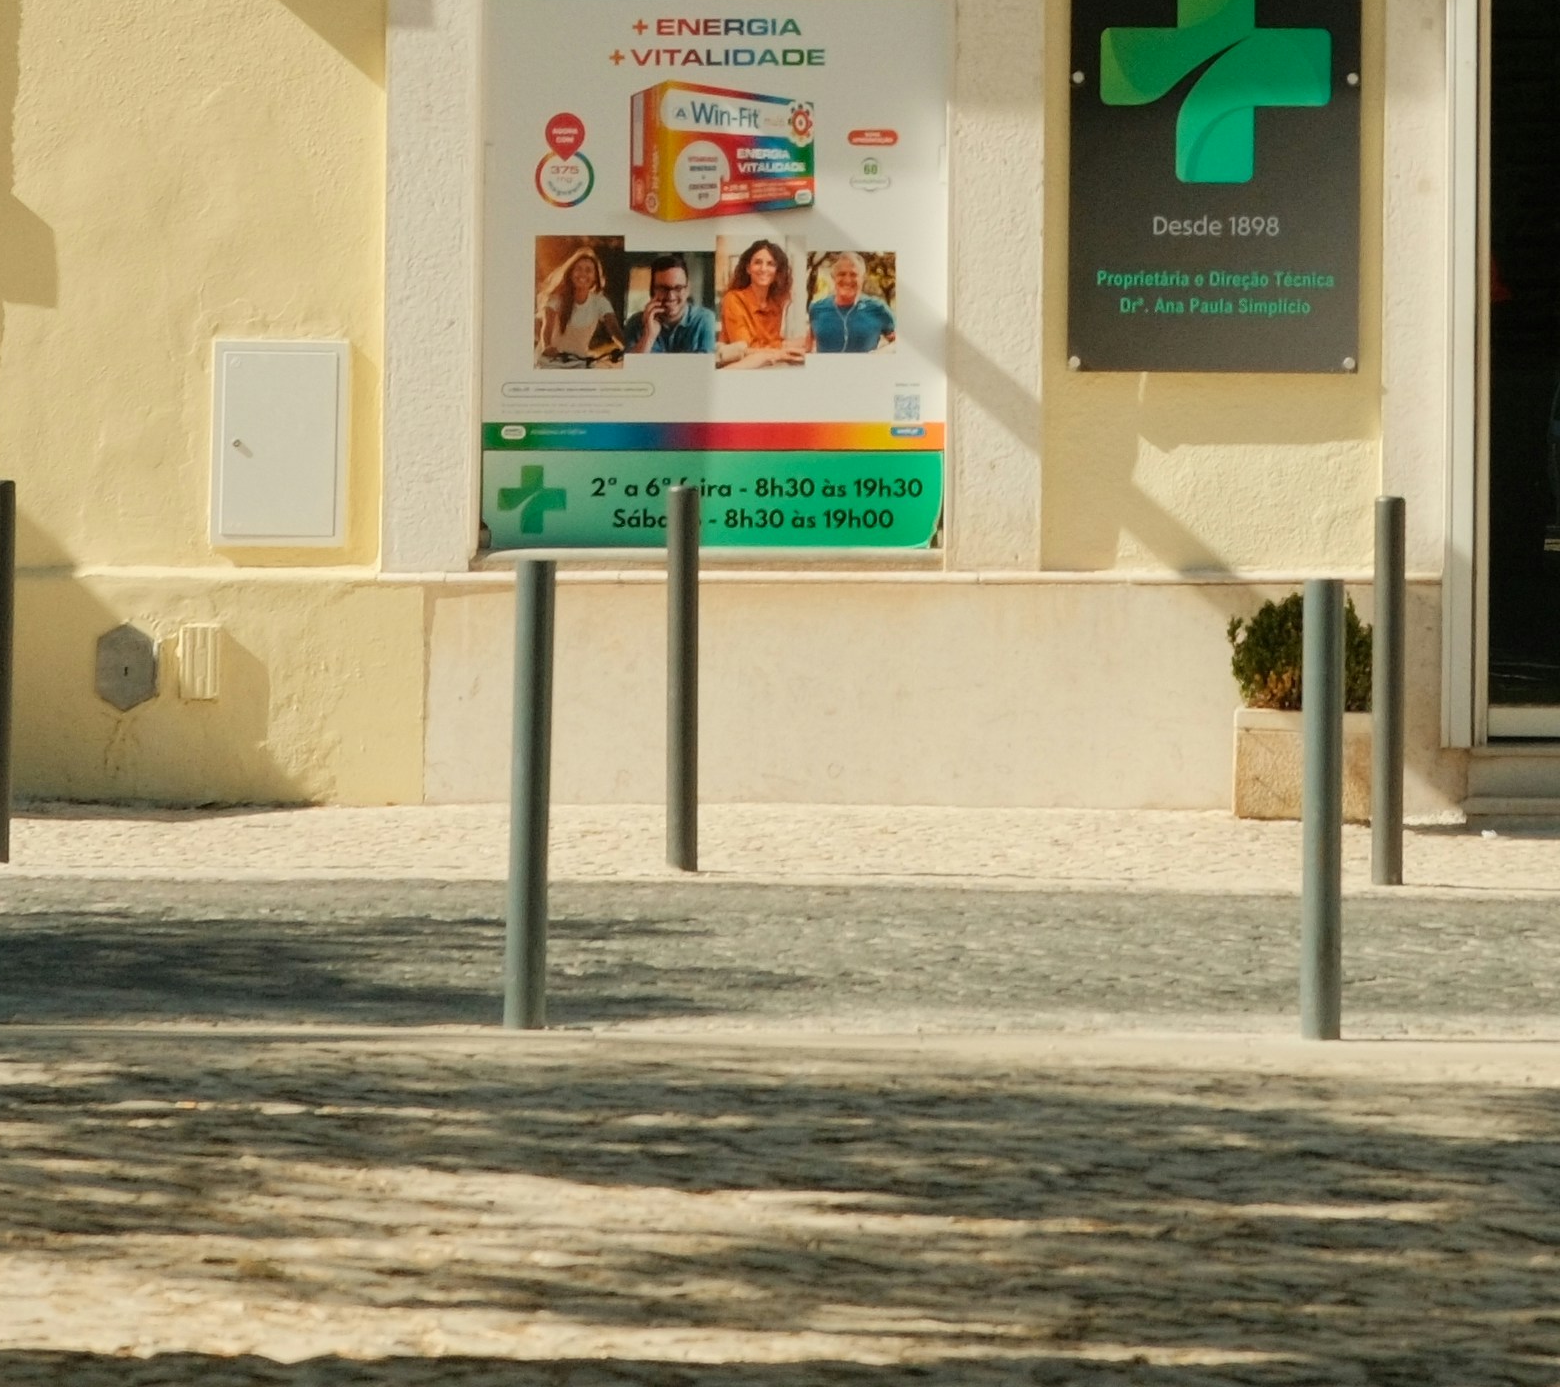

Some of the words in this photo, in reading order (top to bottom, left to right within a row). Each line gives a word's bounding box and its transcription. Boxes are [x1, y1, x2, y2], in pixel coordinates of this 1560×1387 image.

[656, 18, 802, 36] ENERGIA
[631, 48, 826, 66] VITALIDADE
[691, 101, 759, 129] Win-Fit
[1152, 215, 1222, 236] Desde
[1229, 216, 1280, 236] 1898
[1096, 270, 1189, 289] Proprietária
[1209, 271, 1269, 290] Direção
[1273, 271, 1335, 288] Técnica
[1155, 298, 1184, 314] Ana
[1190, 298, 1232, 314] Paula
[1238, 298, 1311, 317] Simplício
[625, 483, 637, 497] a
[754, 478, 814, 497] 8h30
[821, 479, 846, 498] às
[854, 478, 923, 498] 19h30
[724, 510, 784, 528] 8h30
[791, 510, 816, 529] às
[823, 510, 894, 529] 19h00
